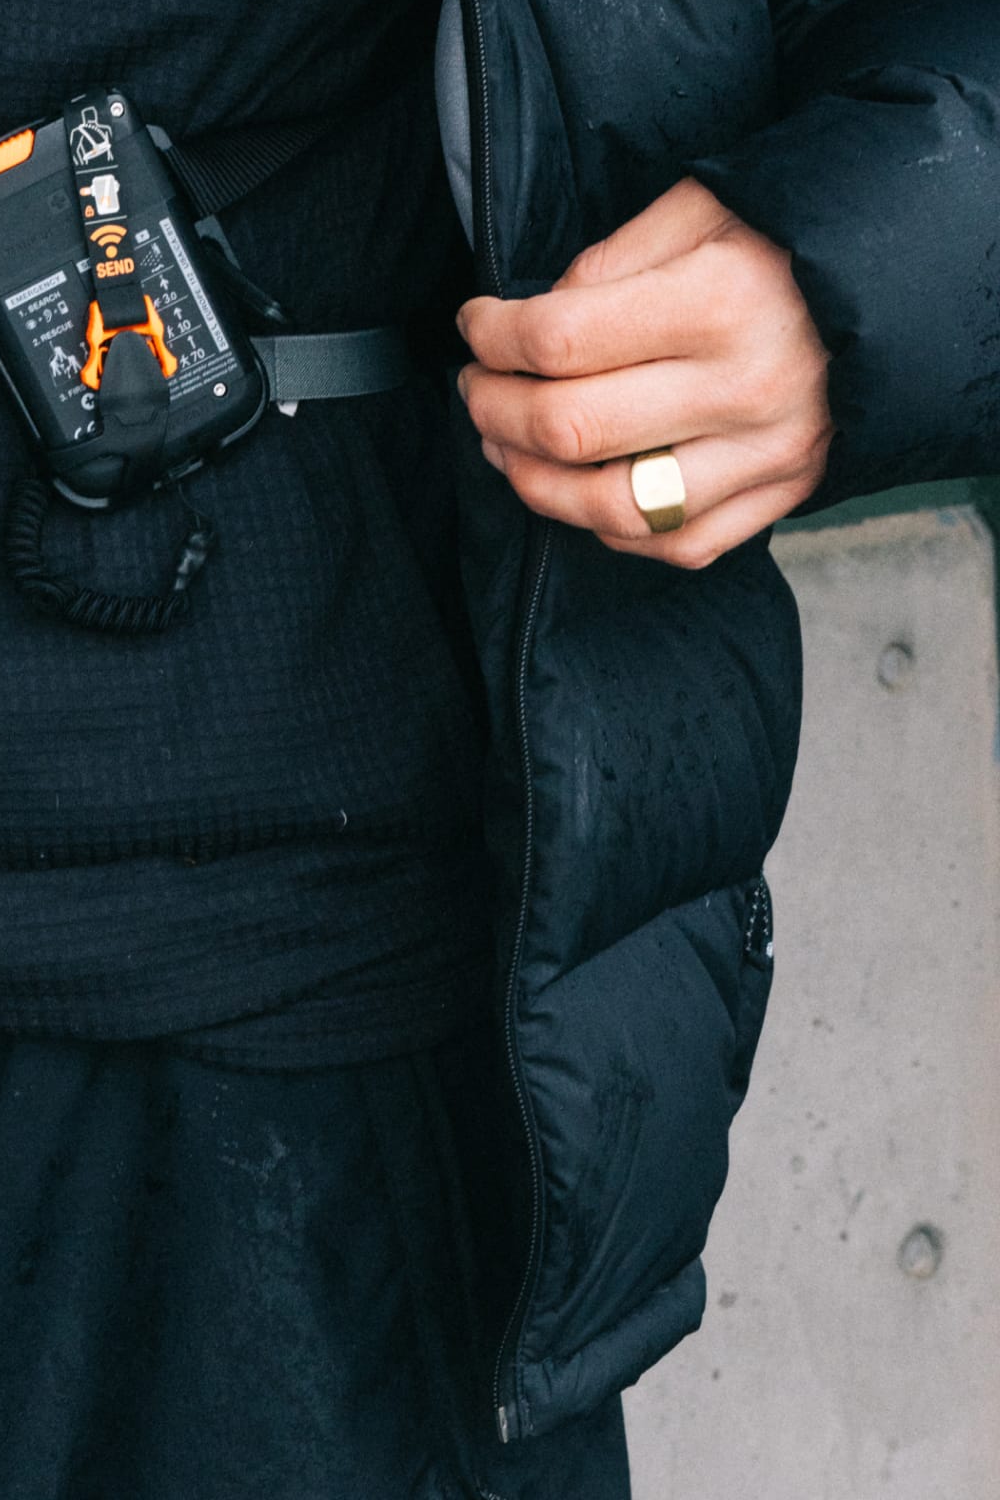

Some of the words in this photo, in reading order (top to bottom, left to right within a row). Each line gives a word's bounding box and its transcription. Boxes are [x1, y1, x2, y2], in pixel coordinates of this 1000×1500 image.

[96, 257, 135, 279] SEND
[9, 275, 61, 306] EMERGENCY
[28, 290, 61, 313] SEARCH
[40, 320, 74, 342] RESCUE
[178, 319, 191, 333] 10
[190, 347, 205, 362] 70
